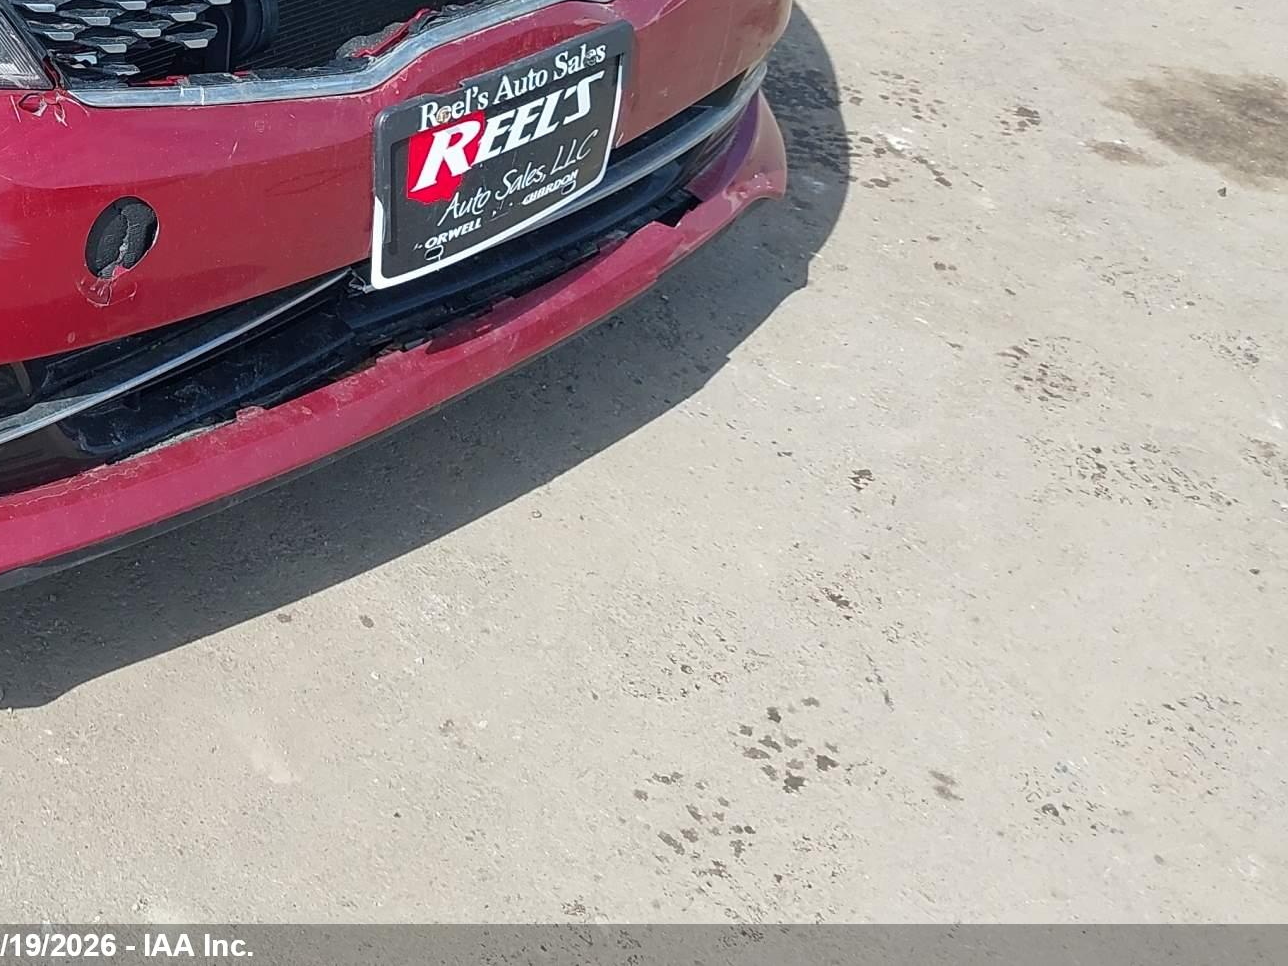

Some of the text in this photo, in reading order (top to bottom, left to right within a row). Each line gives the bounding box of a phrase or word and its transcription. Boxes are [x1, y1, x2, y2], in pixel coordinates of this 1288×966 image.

[418, 43, 607, 132] Reel's Auto Sales
[424, 169, 580, 249] ORWELL CHARDON
[437, 189, 491, 227] Auto
[494, 161, 547, 201] Sales,
[551, 129, 599, 177] LLC
